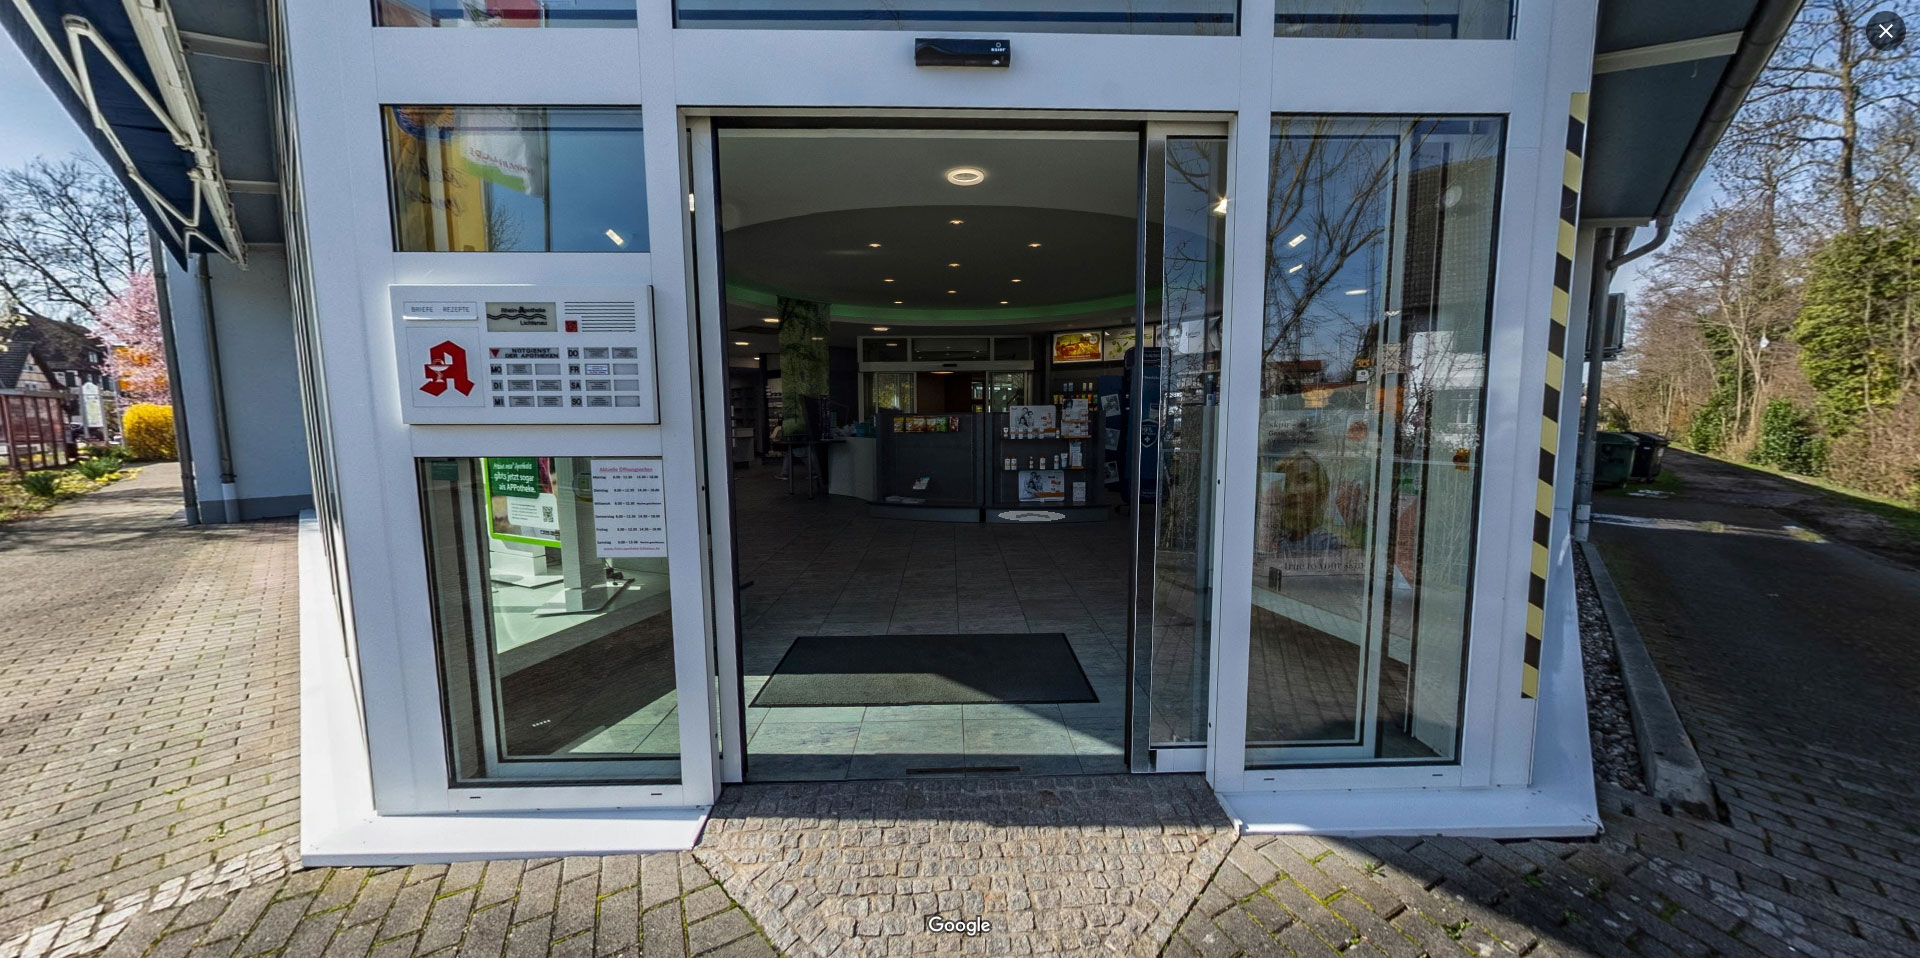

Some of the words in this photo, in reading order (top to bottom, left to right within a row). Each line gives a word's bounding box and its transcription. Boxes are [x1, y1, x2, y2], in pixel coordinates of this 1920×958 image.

[501, 306, 546, 314] Rhein-Apotheke
[491, 366, 502, 374] MO
[507, 472, 519, 482] jetzt
[520, 474, 534, 483] sogar
[1285, 562, 1305, 571] true
[1307, 562, 1317, 570] to
[1317, 562, 1342, 572] your
